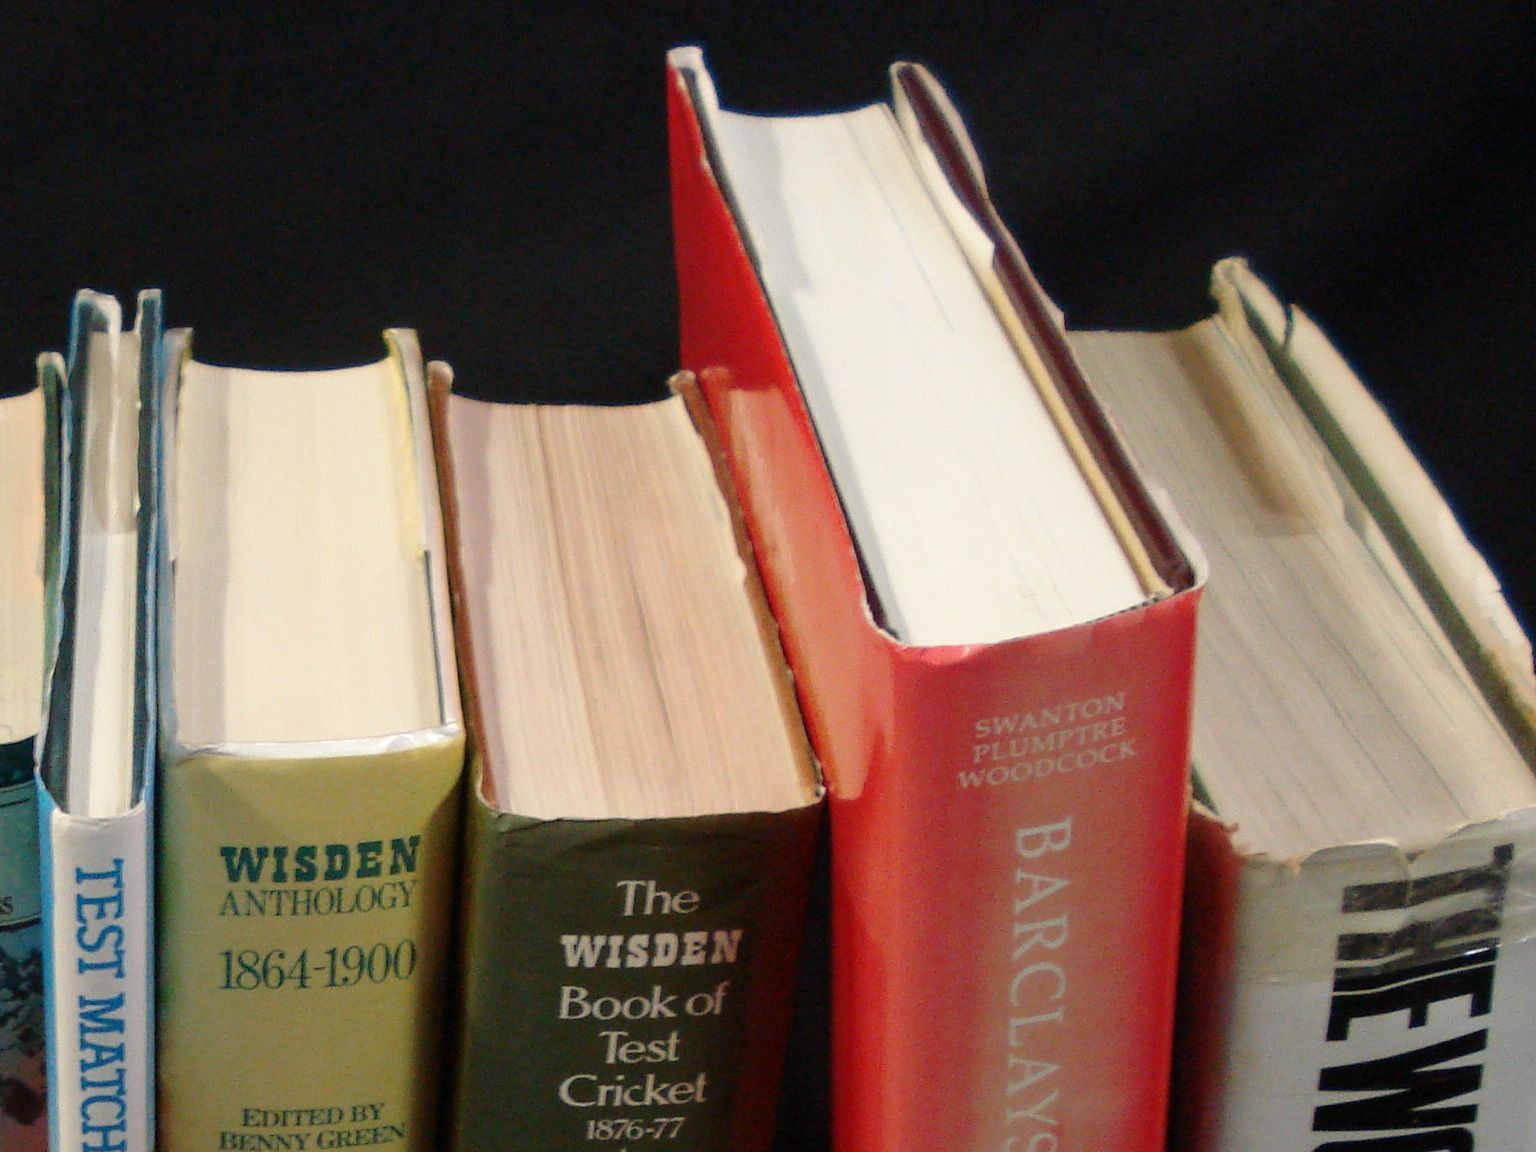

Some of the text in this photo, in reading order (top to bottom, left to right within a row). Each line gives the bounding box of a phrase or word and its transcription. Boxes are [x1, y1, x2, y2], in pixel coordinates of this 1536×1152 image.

[974, 693, 1126, 738] SWANTON
[973, 717, 1126, 763] PLUMPTRE
[958, 740, 1137, 788] WOODCOCK
[220, 835, 421, 883] WISDEN
[219, 880, 417, 917] ANTHOLOGY
[616, 880, 700, 916] The
[75, 858, 126, 979] TEST
[560, 930, 743, 970] WISDEN
[1325, 843, 1515, 1042] THE
[218, 940, 416, 991] 1864-1900
[559, 981, 731, 1021] Book of
[598, 1030, 680, 1065] Test
[559, 1073, 707, 1108] Cricket
[242, 1103, 386, 1128] EDITED BY
[586, 1117, 686, 1141] 1876-77
[218, 1123, 407, 1152] BENNY GREEN
